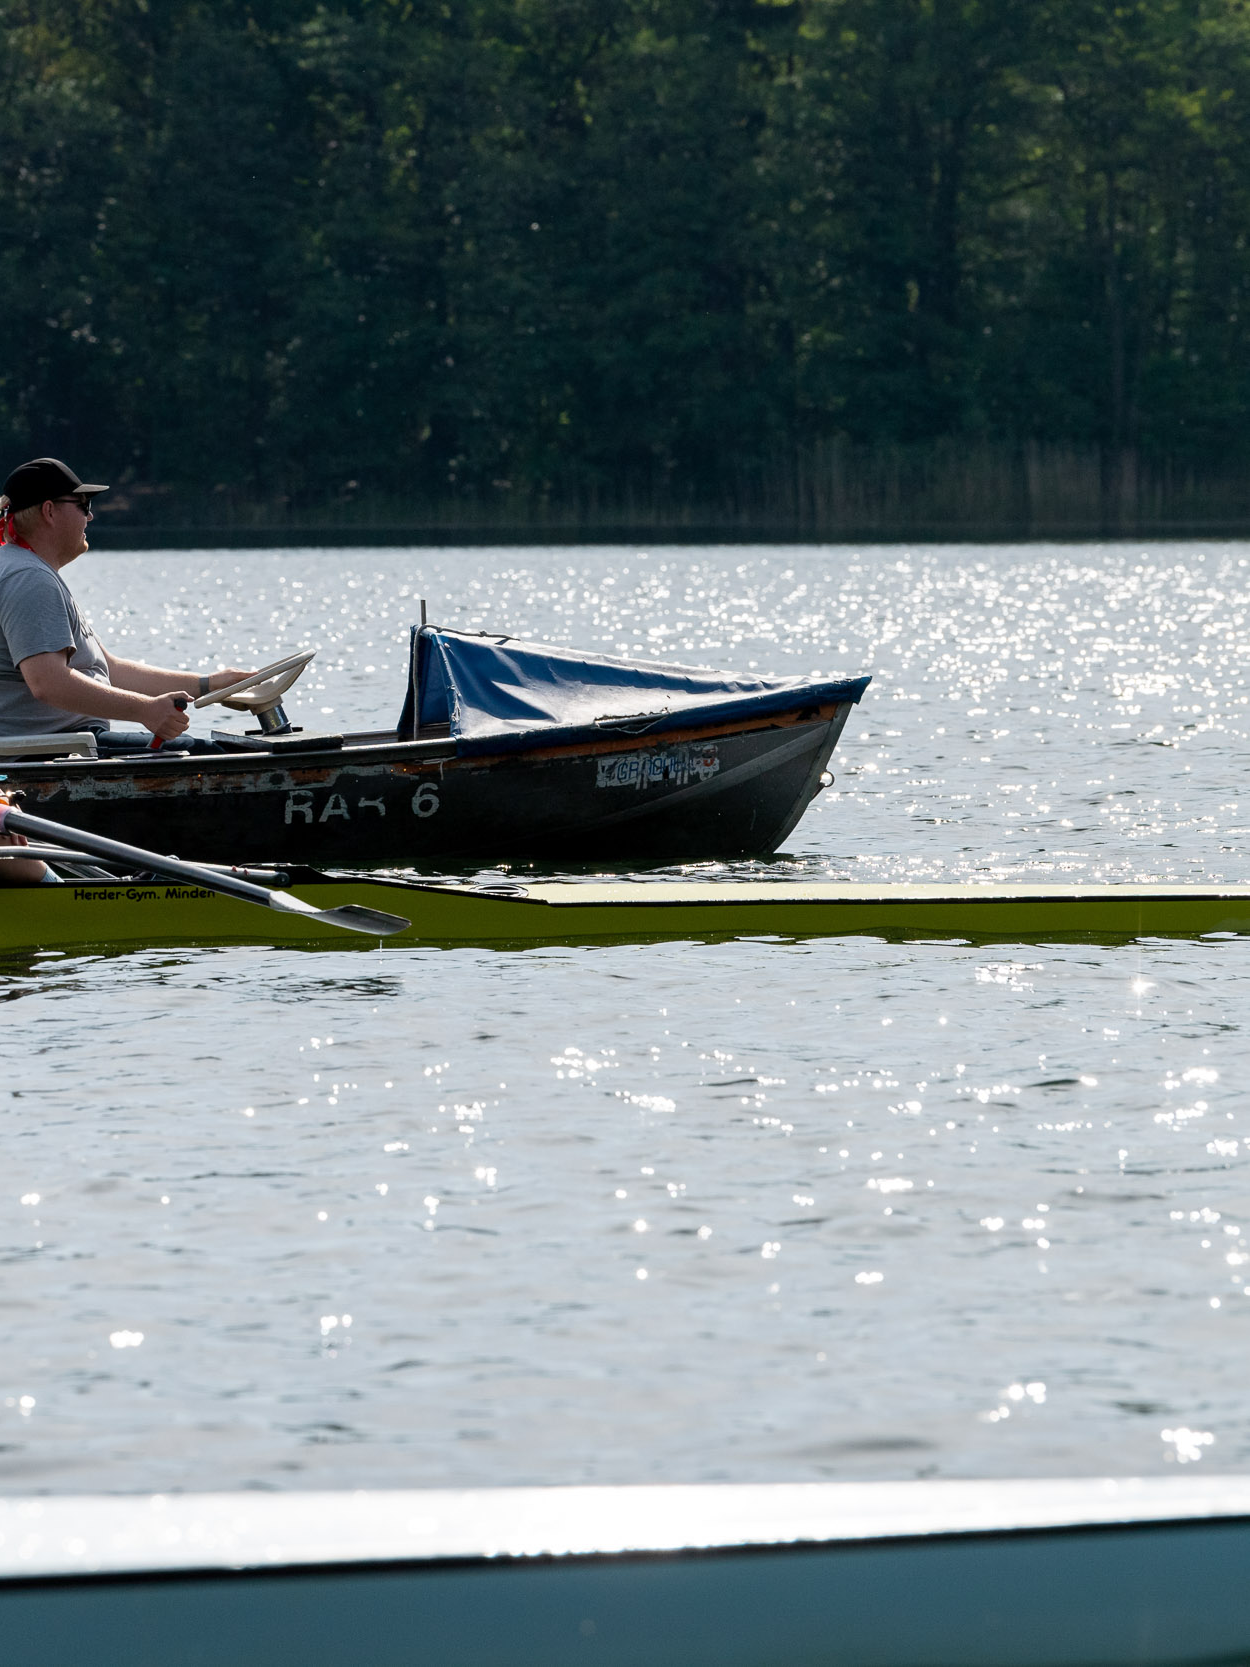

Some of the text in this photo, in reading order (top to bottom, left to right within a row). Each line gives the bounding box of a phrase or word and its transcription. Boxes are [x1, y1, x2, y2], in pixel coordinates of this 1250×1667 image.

[411, 782, 440, 818] 6
[74, 887, 216, 902] Herder-Gym. Minden
